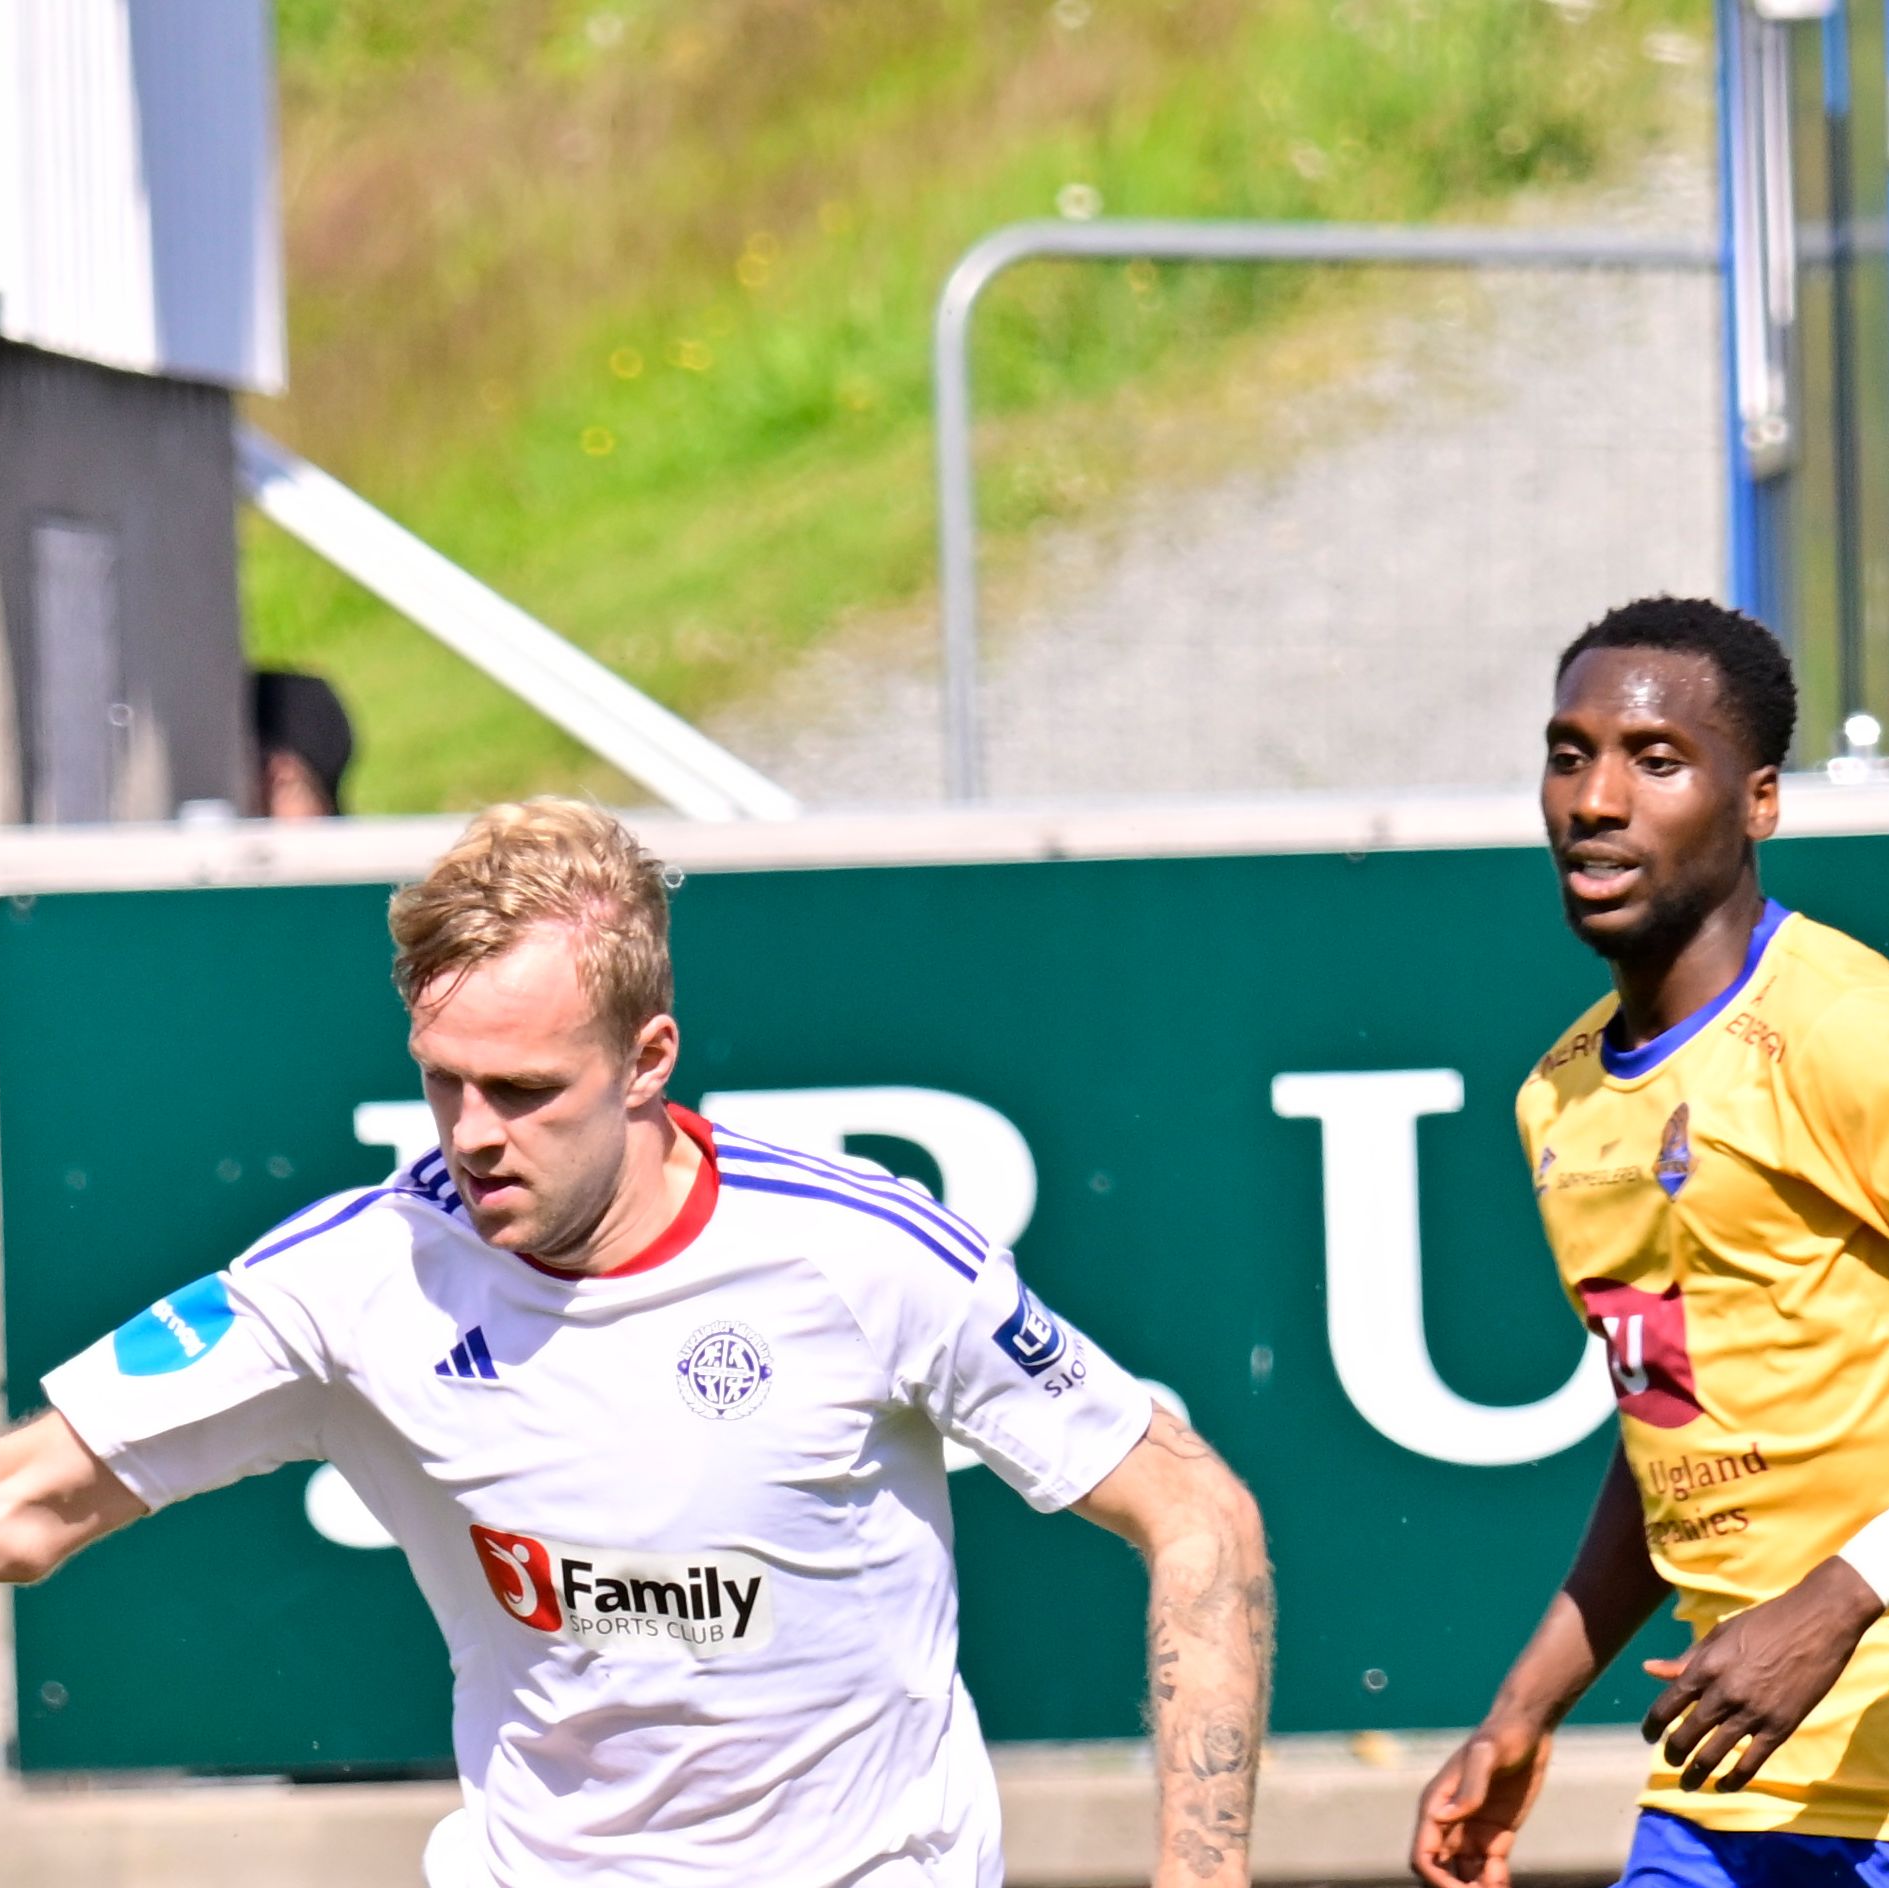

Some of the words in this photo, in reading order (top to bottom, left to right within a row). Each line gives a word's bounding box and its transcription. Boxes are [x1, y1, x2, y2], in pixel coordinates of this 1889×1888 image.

[561, 1557, 763, 1640] Family
[569, 1614, 660, 1638] SPORTS
[666, 1619, 725, 1646] CLUB
